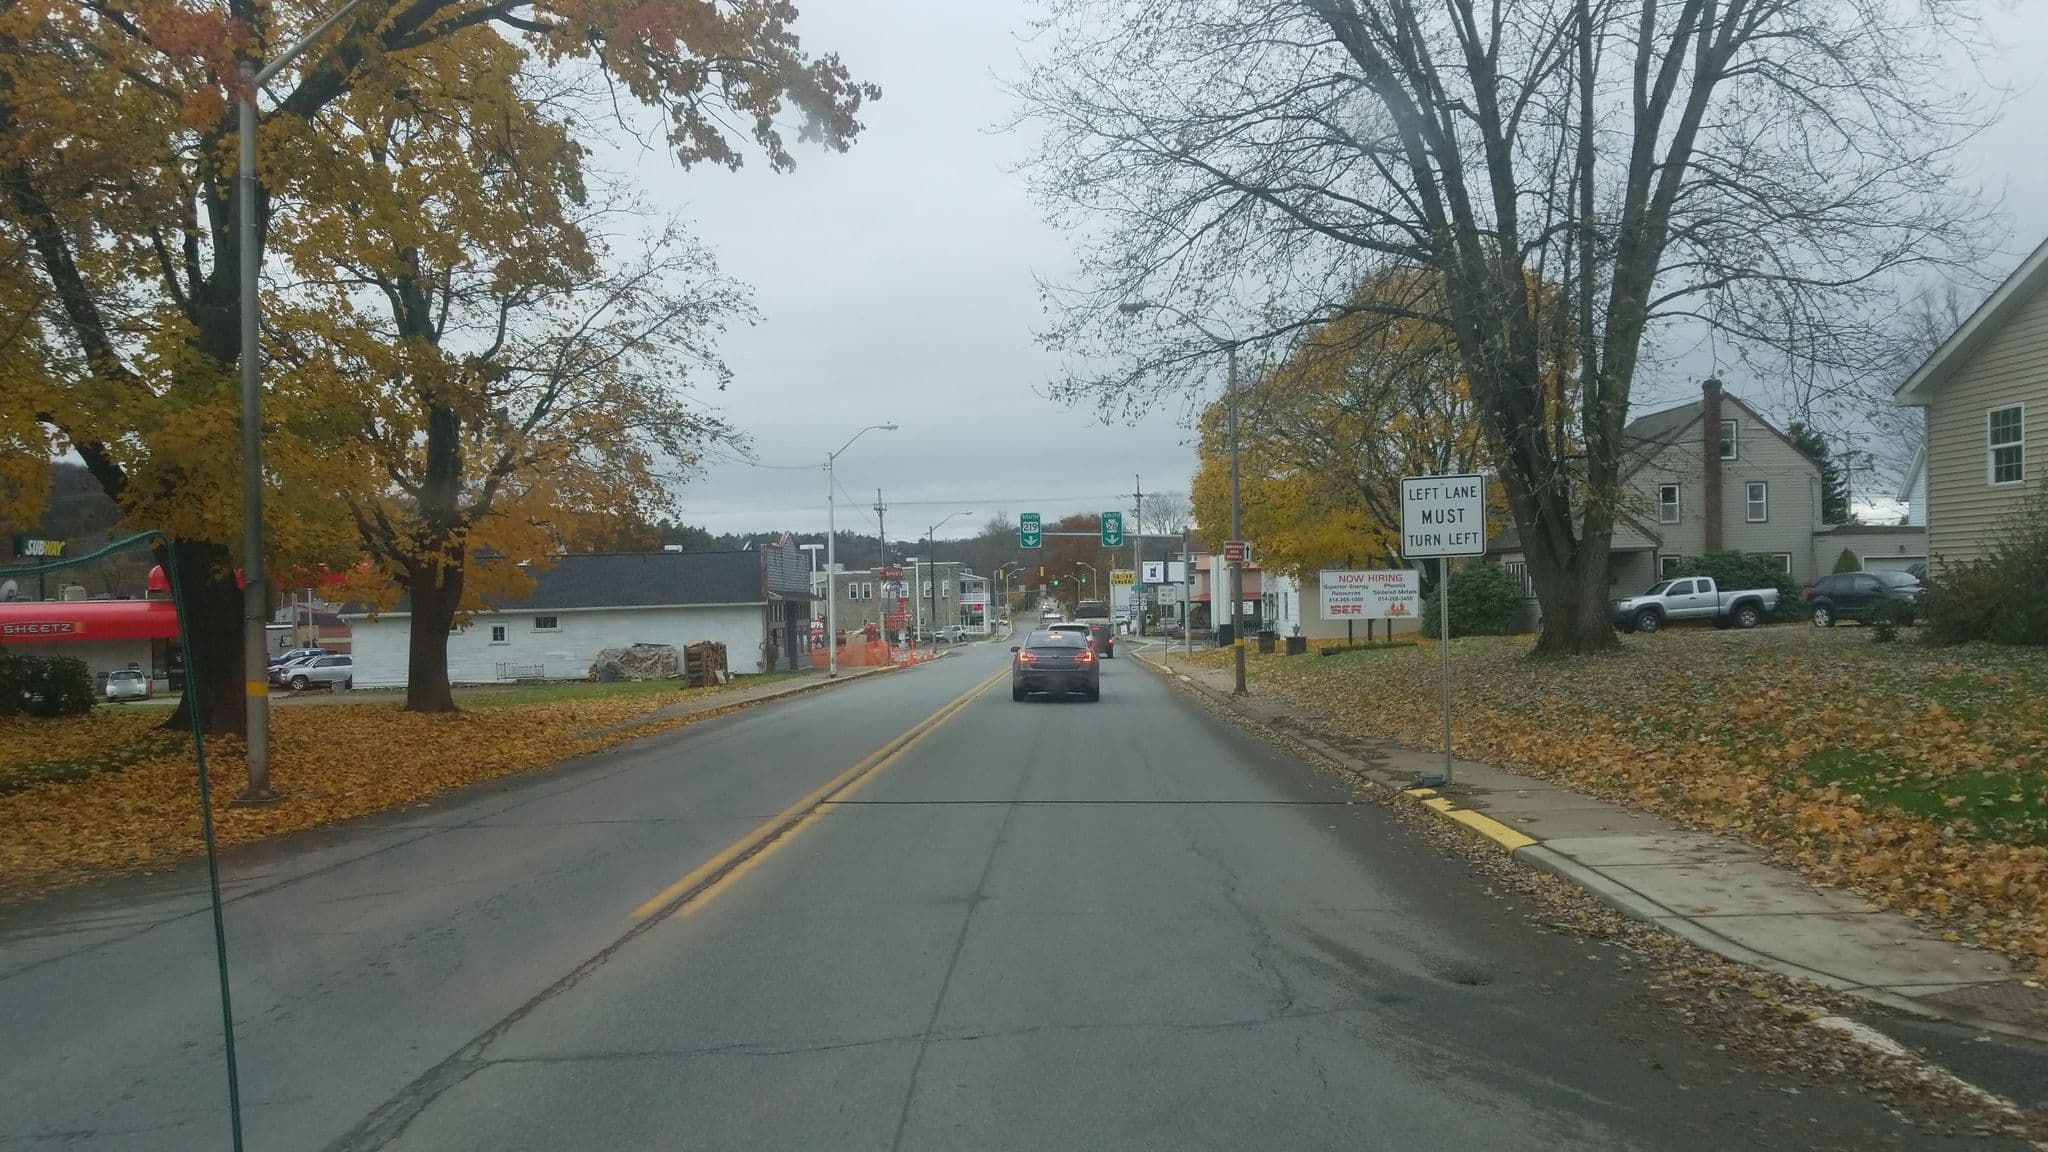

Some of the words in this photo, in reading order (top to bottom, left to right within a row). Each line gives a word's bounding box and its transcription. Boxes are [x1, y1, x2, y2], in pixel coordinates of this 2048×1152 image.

[1409, 487, 1439, 501] LEFT
[1445, 485, 1478, 499] LANE
[1422, 508, 1465, 525] MUST
[1023, 523, 1038, 532] 219
[1106, 523, 1117, 532] 28
[1408, 534, 1441, 547] TURN
[1448, 532, 1479, 545] LEFT
[25, 539, 66, 556] SUBWAY
[1338, 575, 1365, 583] NOW
[1368, 574, 1403, 582] HIRING
[1330, 605, 1362, 615] SER
[3, 623, 70, 634] SHEETZ
